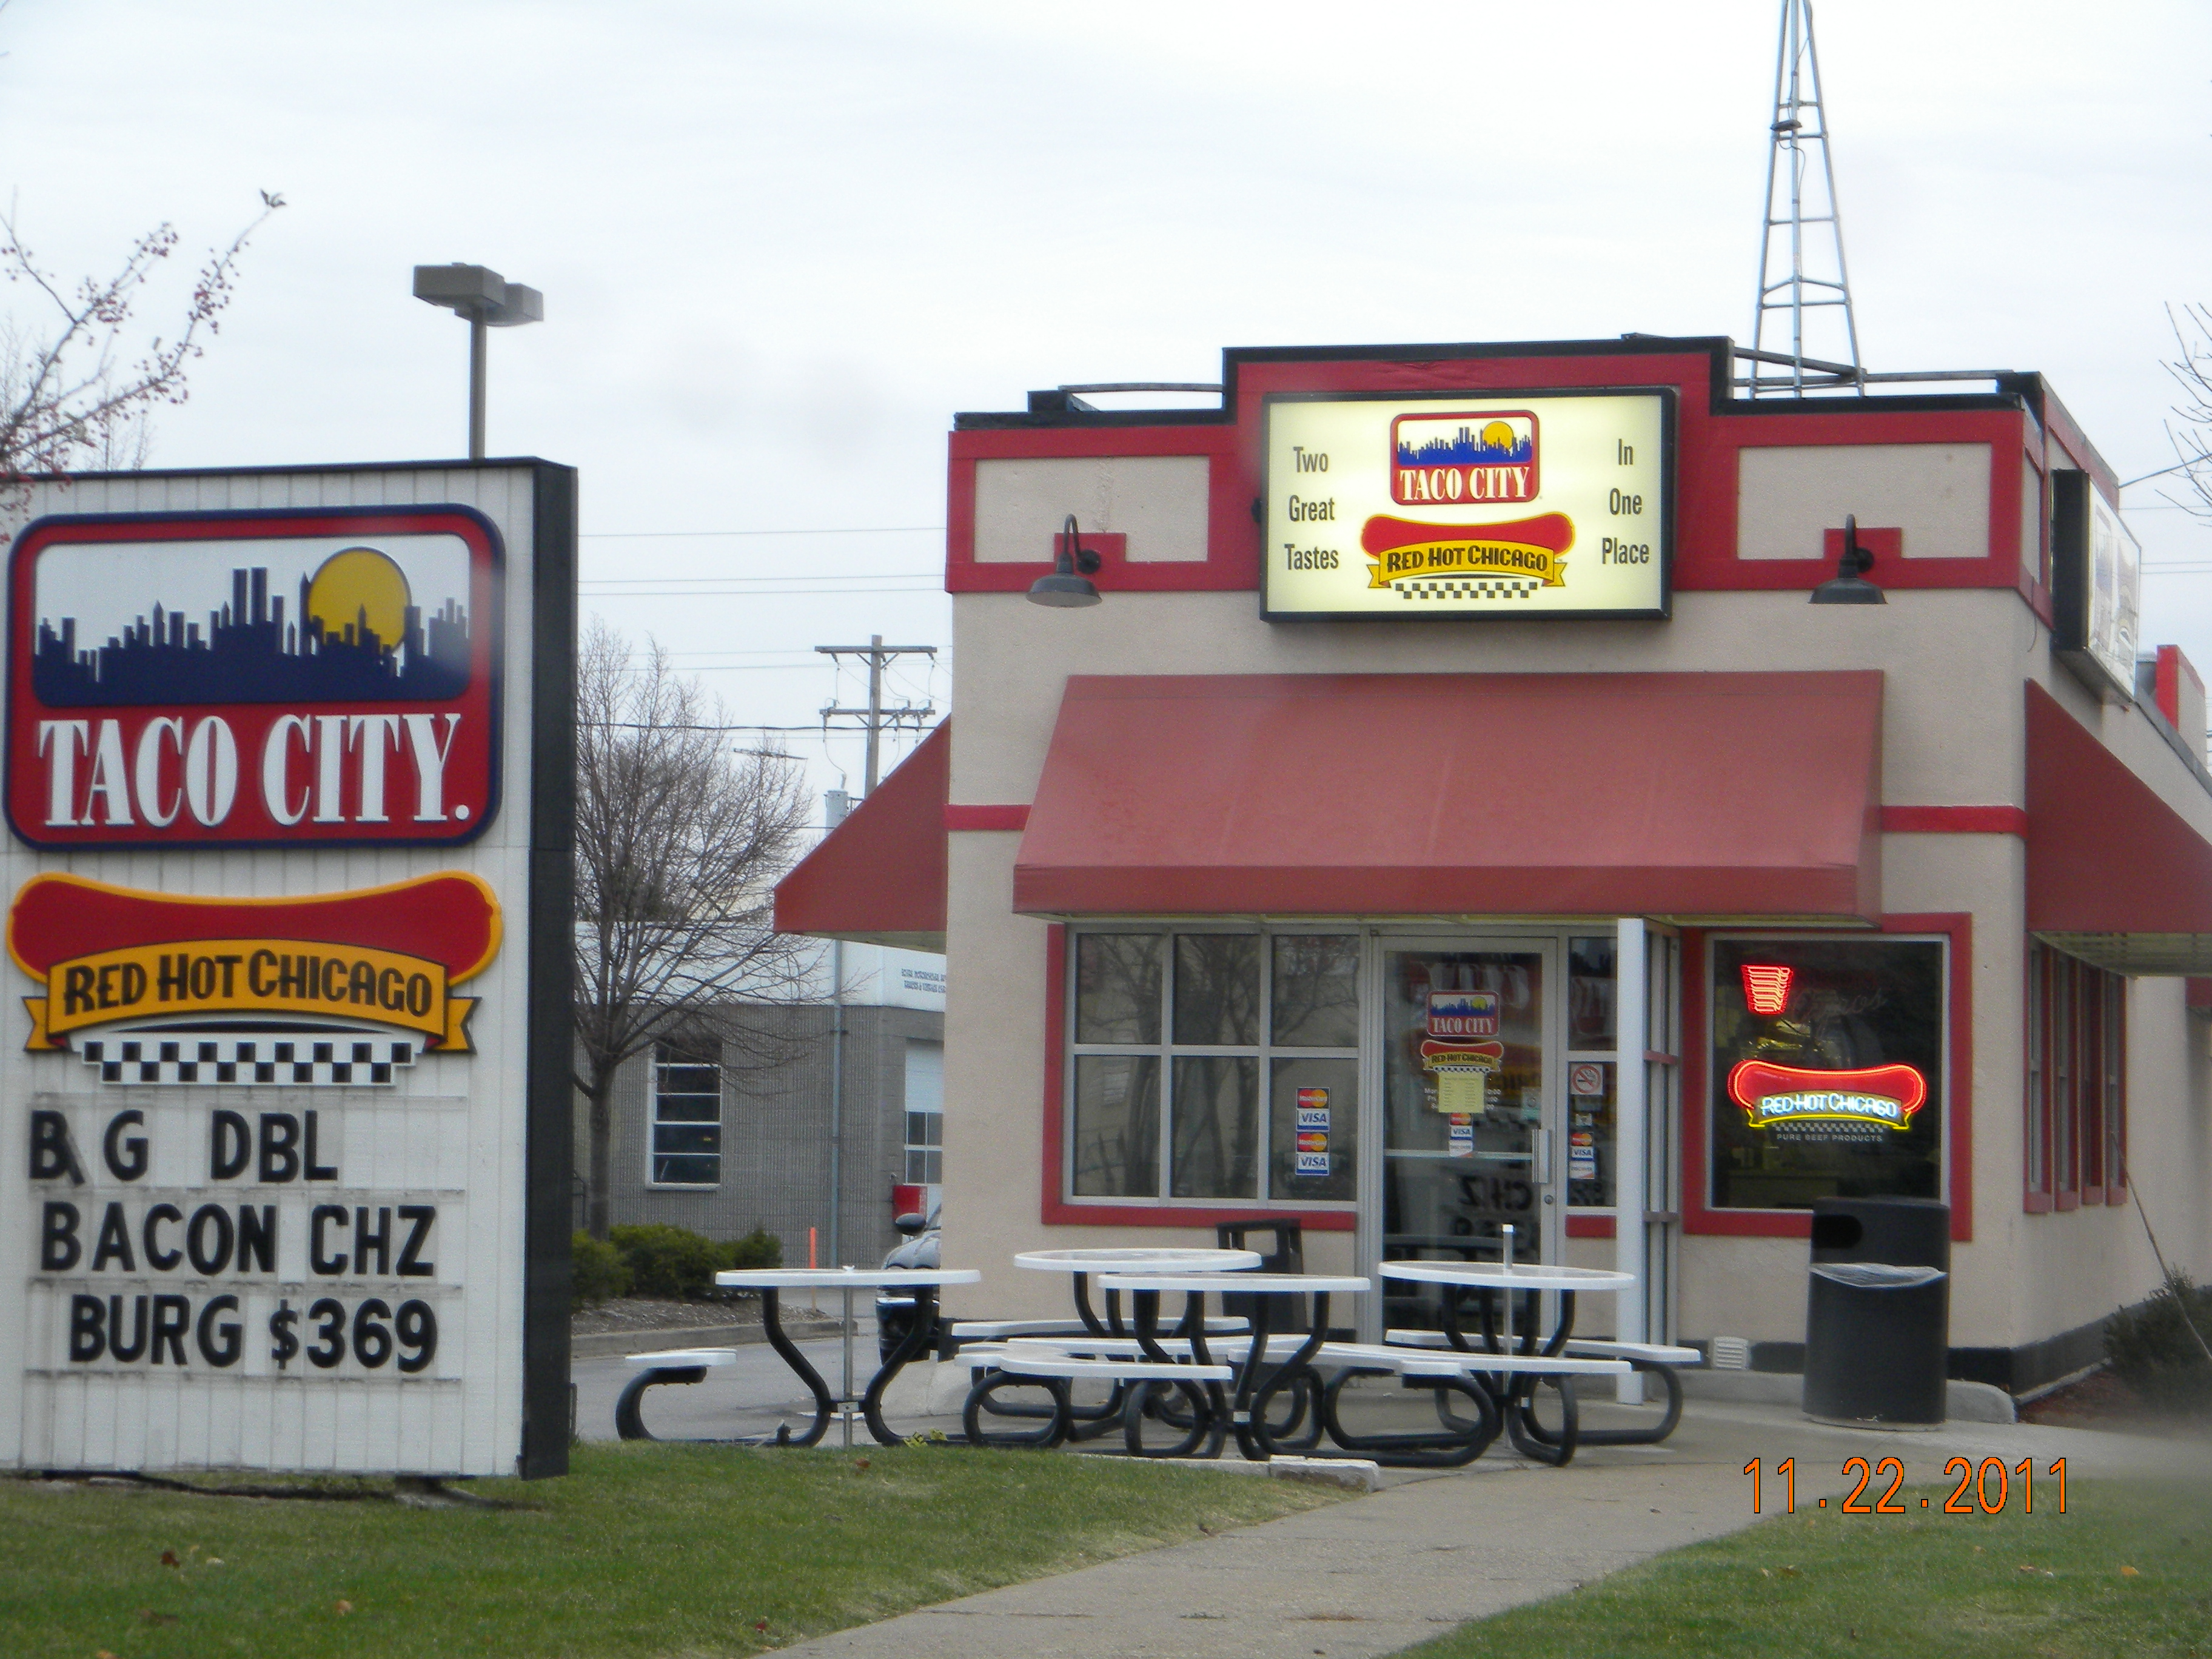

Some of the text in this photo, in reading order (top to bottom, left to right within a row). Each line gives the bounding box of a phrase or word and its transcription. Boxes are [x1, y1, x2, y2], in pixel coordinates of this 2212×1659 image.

[1293, 446, 1329, 473] Two
[1618, 438, 1634, 465] In
[1400, 466, 1529, 501] TACO CITY
[1289, 495, 1335, 521] Great
[1609, 488, 1642, 515] One
[1284, 544, 1339, 570] Tastes
[1387, 545, 1547, 572] RED HOT CHICAGO
[1602, 537, 1649, 565] Place
[39, 716, 238, 828] TACO
[64, 948, 432, 1017] RED HOT CHICAGO
[1432, 1017, 1494, 1033] TACO CITY
[1431, 1054, 1446, 1064] RED
[1462, 1053, 1493, 1064] CHICAGO
[1301, 1112, 1327, 1122] VISA
[1760, 1092, 1898, 1118] RED HOT CHICAGO
[210, 1110, 338, 1183] DBL
[1300, 1156, 1326, 1166] VISA
[41, 1201, 437, 1276] BACON CHZ
[70, 1294, 438, 1373] BURG $369
